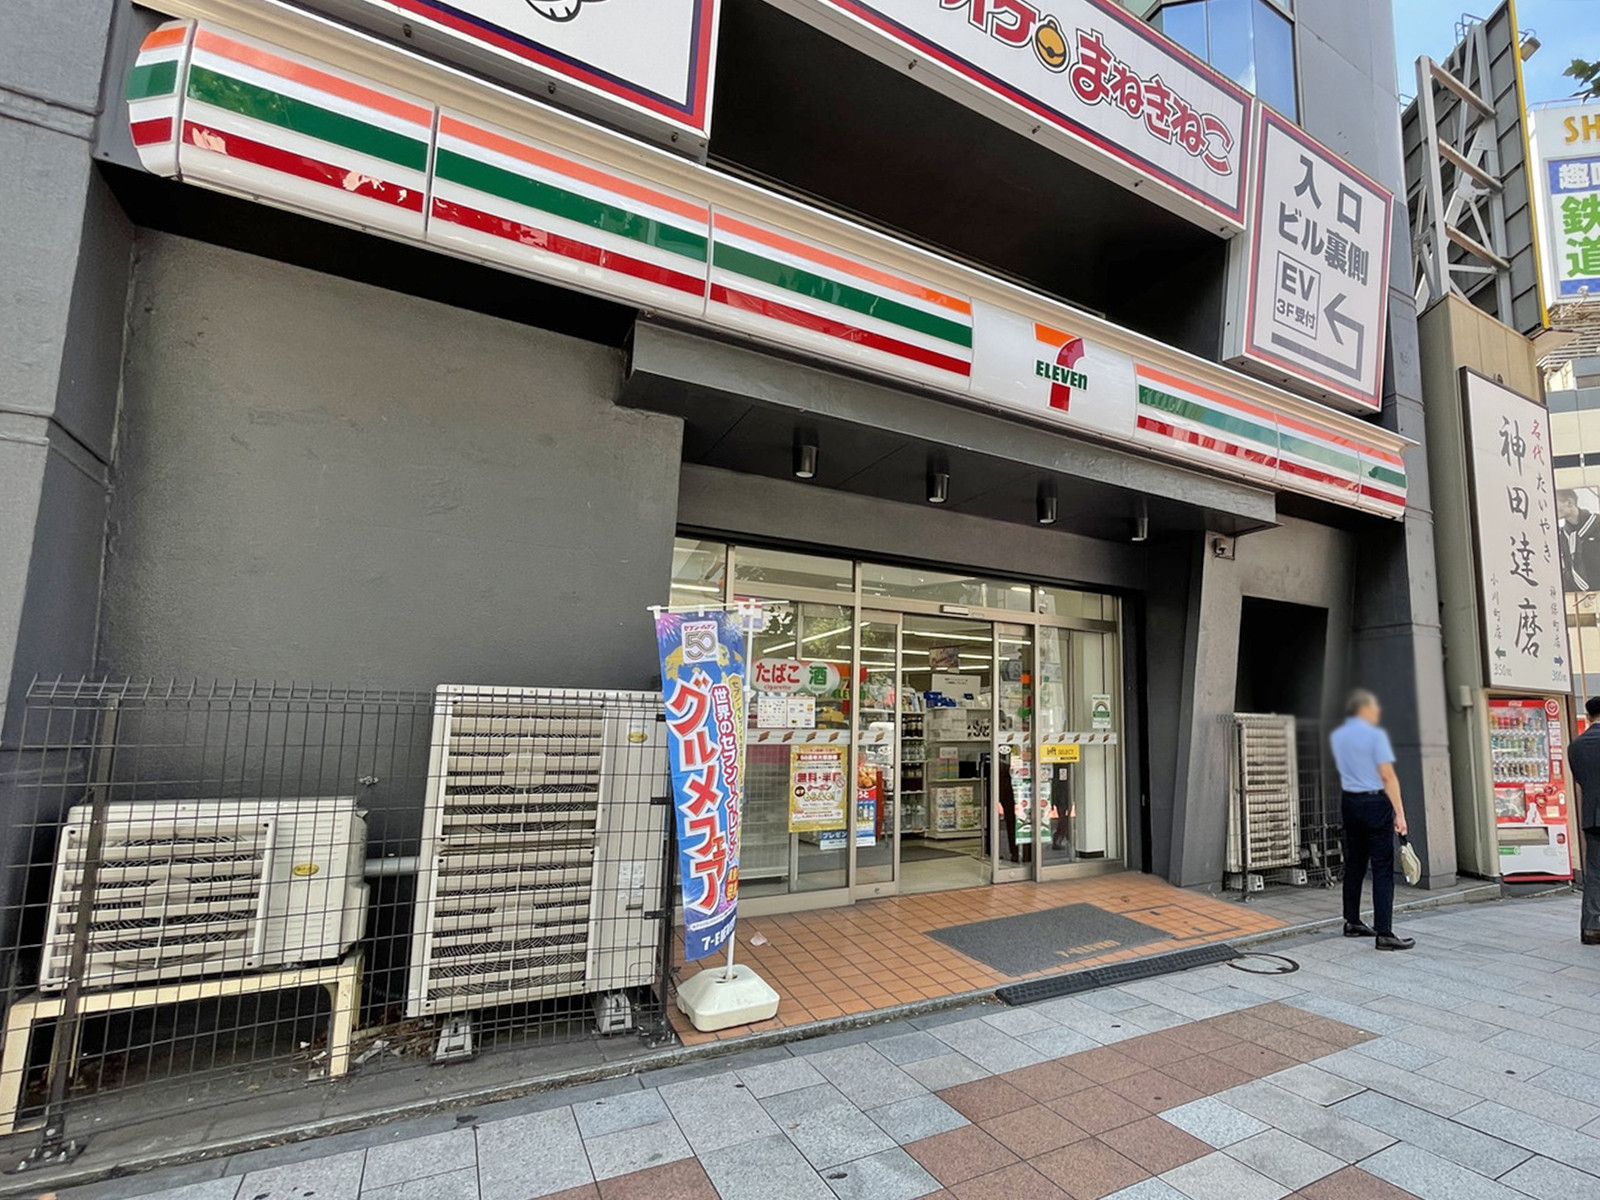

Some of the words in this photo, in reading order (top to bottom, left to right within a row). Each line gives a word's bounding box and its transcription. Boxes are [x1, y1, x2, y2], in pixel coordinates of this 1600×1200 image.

[1071, 31, 1233, 175] まねきねこ
[1294, 154, 1362, 234] 入口
[1278, 201, 1369, 286] ビル裏側
[1281, 261, 1315, 301] EV
[1277, 299, 1316, 330] 3F受付
[1500, 415, 1543, 658] 神田達磨
[684, 630, 717, 661] 50
[756, 662, 800, 683] たばこ
[809, 665, 828, 685] 酒
[667, 673, 727, 912] グルメフェア
